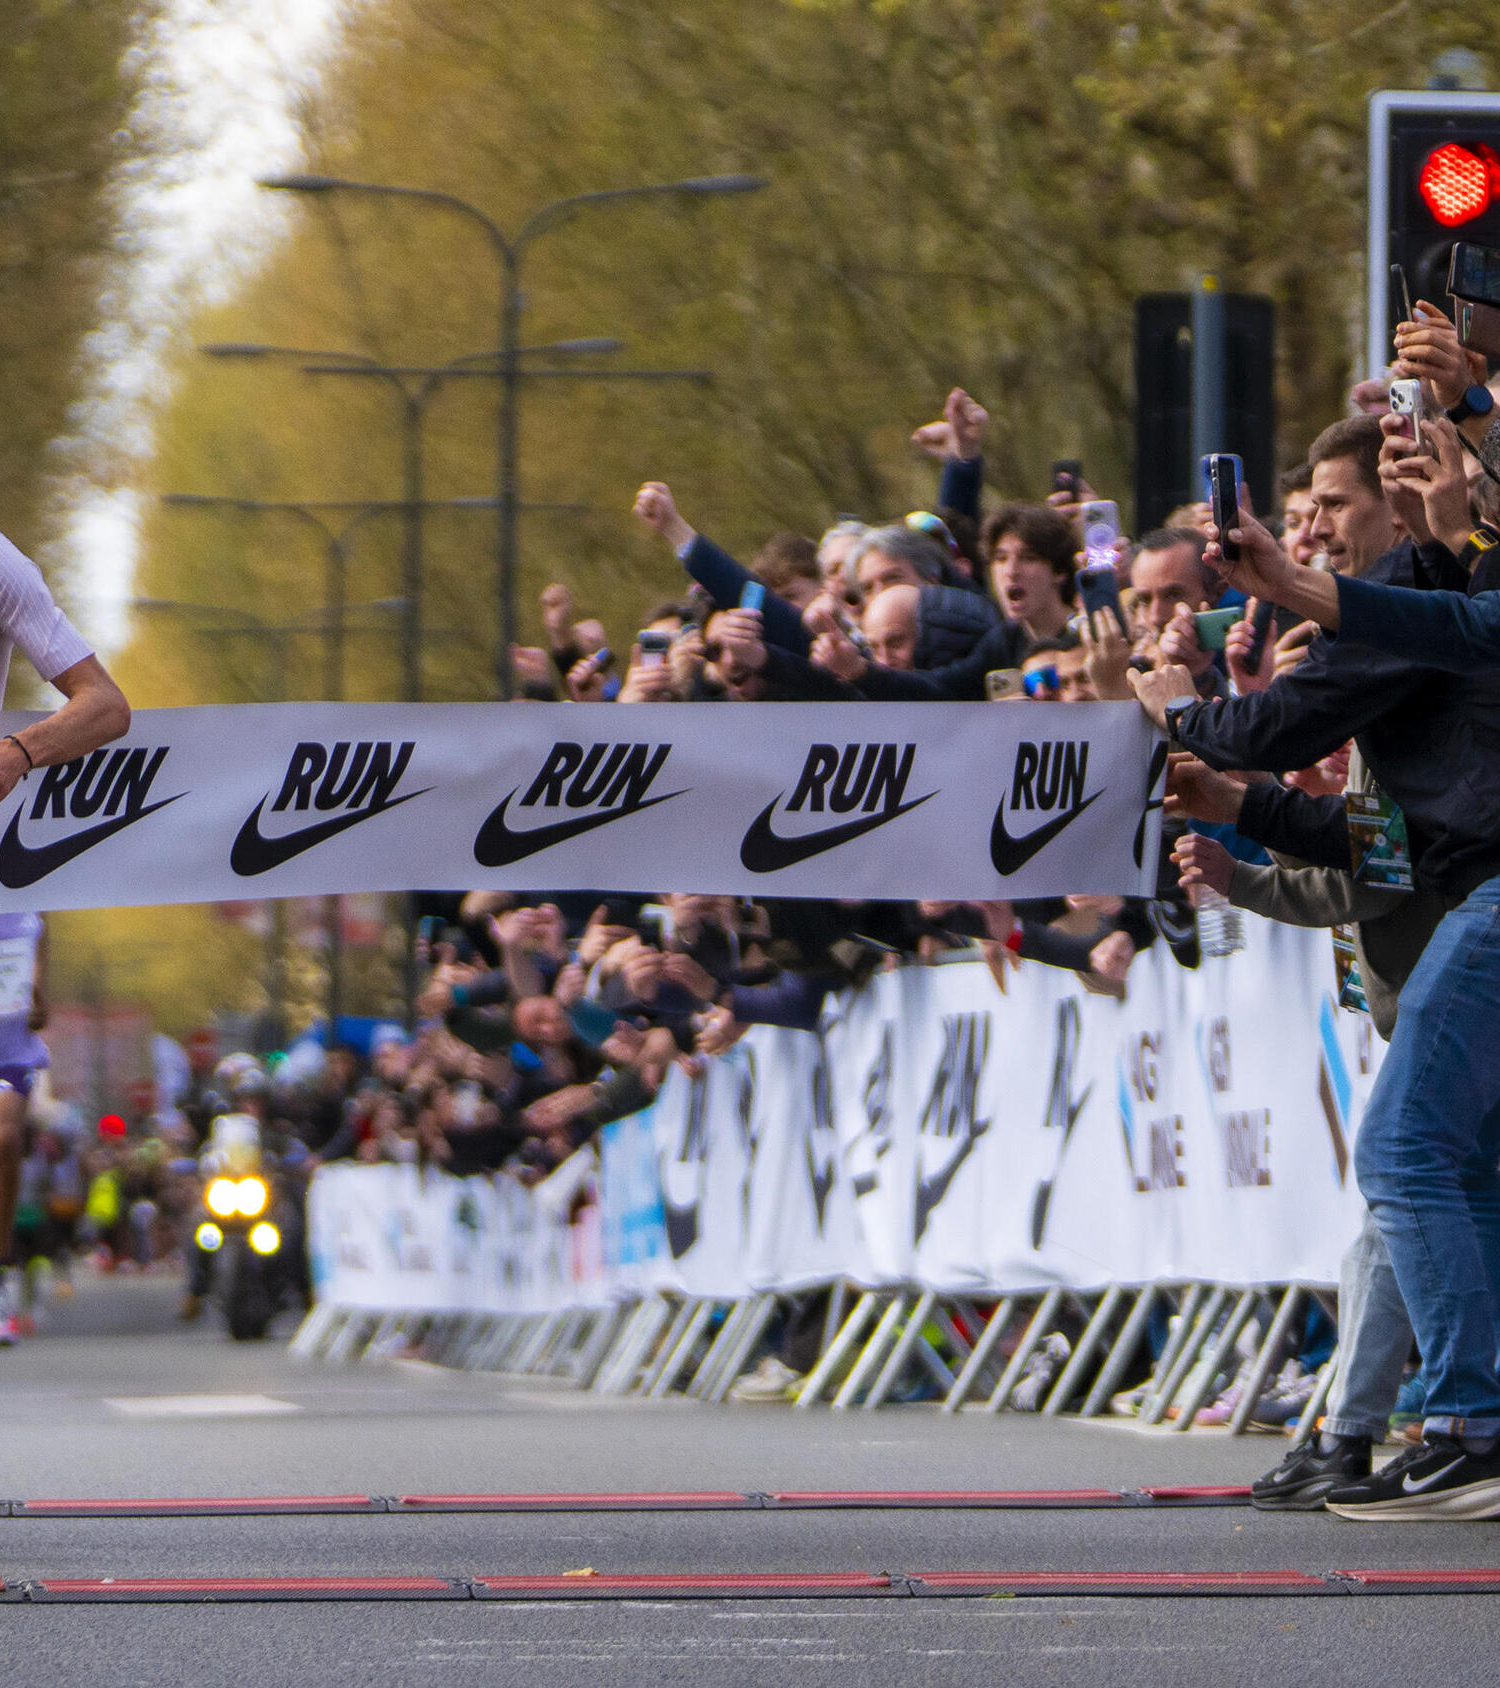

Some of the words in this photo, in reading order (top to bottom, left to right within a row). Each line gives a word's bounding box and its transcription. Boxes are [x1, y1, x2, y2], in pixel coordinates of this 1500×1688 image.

[29, 746, 170, 819] RUN
[271, 742, 416, 812] RUN
[519, 742, 673, 808] RUN
[784, 743, 916, 815] RUN
[1010, 741, 1089, 811] RUN
